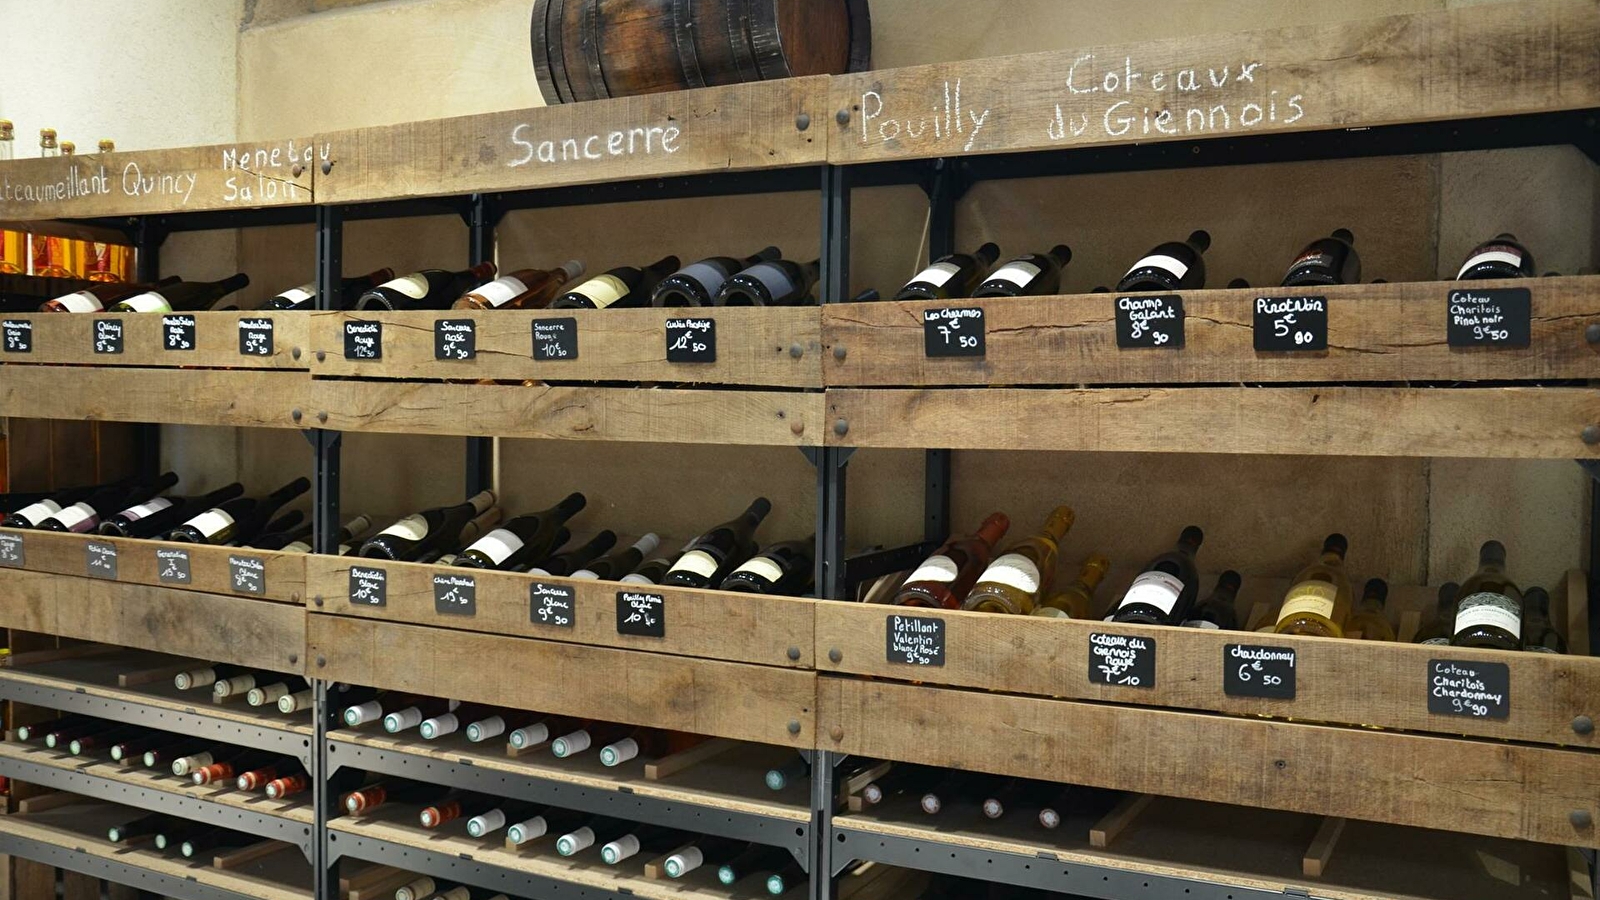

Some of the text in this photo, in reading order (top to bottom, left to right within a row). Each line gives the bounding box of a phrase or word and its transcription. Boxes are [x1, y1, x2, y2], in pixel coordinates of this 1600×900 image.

[1066, 54, 1263, 95] Coteaux
[861, 77, 990, 151] Pouilly
[1047, 91, 1305, 141] du Giennois
[506, 123, 681, 168] Sancerre
[222, 140, 331, 172] Menetou
[122, 162, 197, 204] Quincy
[223, 173, 298, 202] Salon
[1119, 298, 1162, 311] Champ
[1451, 292, 1490, 304] Coteau
[1129, 306, 1175, 321] Galant
[1450, 304, 1500, 315] Charitois
[534, 323, 565, 332] Sancerre
[1454, 316, 1480, 326] Pinot
[894, 632, 932, 646] Valentin
[1128, 637, 1147, 650] du
[1433, 676, 1485, 691] Charitois
[1433, 686, 1502, 706] Chardonnay
